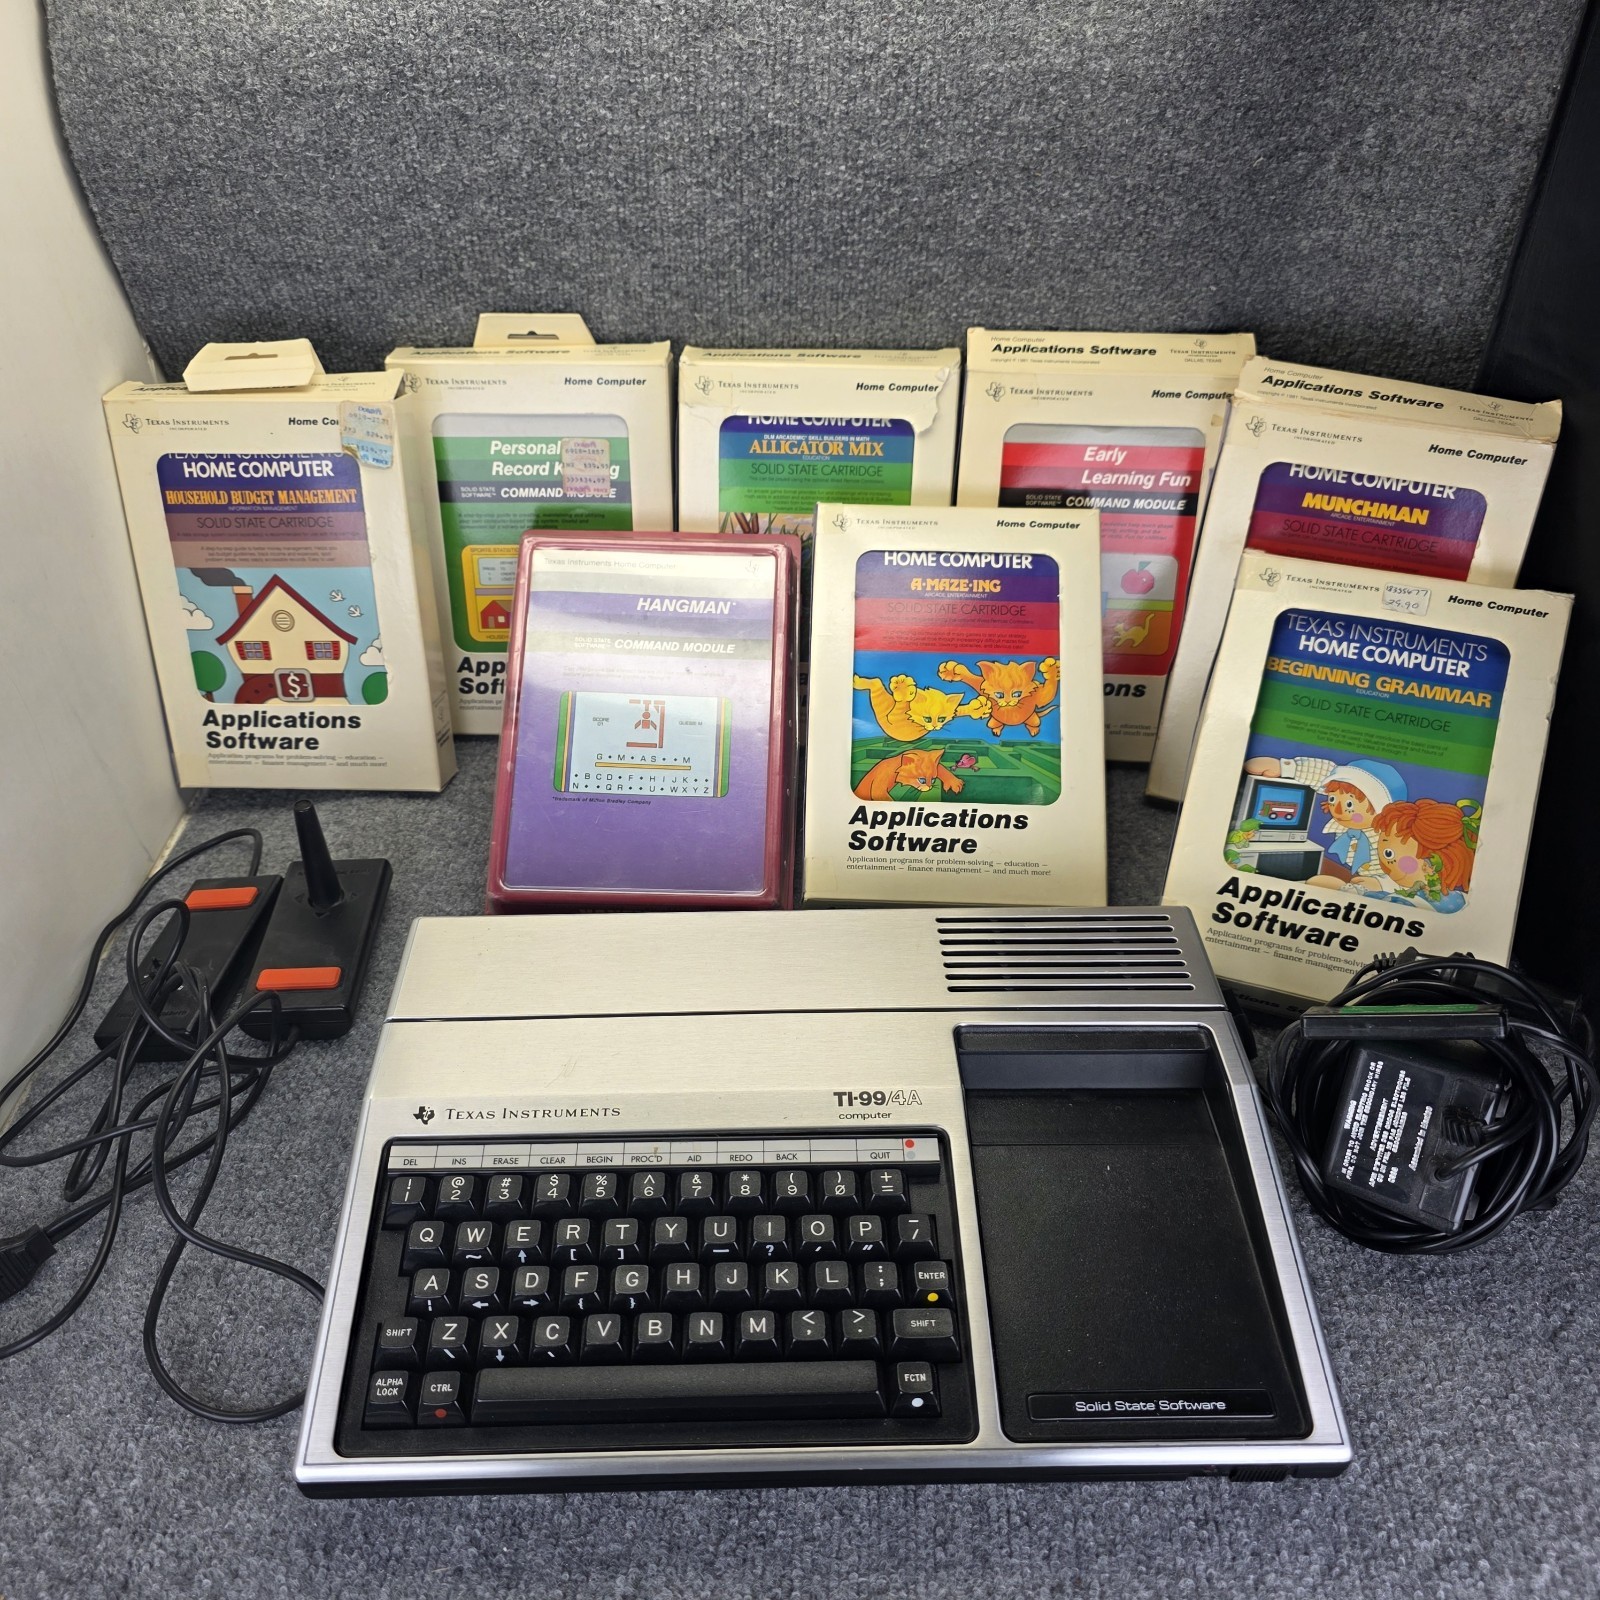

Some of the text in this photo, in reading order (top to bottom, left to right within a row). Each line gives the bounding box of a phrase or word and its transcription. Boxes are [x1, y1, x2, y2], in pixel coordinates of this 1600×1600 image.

[702, 351, 791, 359] Applications
[992, 344, 1157, 356] Applications Software
[1263, 366, 1323, 380] Home Computer
[425, 377, 507, 386] TEXAS INSTRUMENTS
[564, 376, 647, 388] Home Computer
[718, 380, 799, 389] TEXAS INSTRUMENTS
[856, 382, 939, 393] Home Computer
[1009, 386, 1093, 396] TEXAS INSTRUMENTS
[1151, 389, 1234, 400] Home Compute
[1261, 375, 1363, 398] Applications
[1368, 390, 1444, 410] Software
[145, 418, 230, 426] TEXAS INSTRUMENTS
[288, 417, 318, 426] Home
[747, 415, 799, 426] HOME
[1271, 423, 1363, 443] TEXAS INSTRUMENTS
[490, 440, 561, 455] Personal
[749, 440, 885, 457] ALLIGATOR MIX
[1428, 443, 1528, 466] Home Computer
[1083, 446, 1127, 466] Early
[182, 459, 335, 478] HOME COMPUTER
[491, 461, 550, 476] Record
[751, 463, 883, 477] SOLID STATE CARTRIDGE
[1081, 469, 1192, 489] Learning Fun
[1289, 463, 1458, 499] HOME COMPUTER
[165, 489, 357, 505] HOUSEHOLD BUDGET MANAGEMENT
[500, 487, 564, 498] COMMAND
[1065, 496, 1186, 511] COMMAND MODULE
[1301, 491, 1429, 526] MUNCHMAN
[197, 516, 334, 529] SOLID STATE CARTRIDGE
[856, 518, 939, 527] TEXAS INSTRUMENTS
[996, 520, 1081, 531] Home Computer
[1282, 518, 1320, 536] SOLID
[1323, 524, 1359, 541] STATE
[1362, 530, 1440, 553] CARTRIDGE
[544, 557, 566, 566] Texas
[567, 558, 612, 567] Instruments
[614, 560, 637, 568] Home
[884, 551, 1033, 569] HOME COMPUTER
[1286, 574, 1380, 593] TEXAS INSTRUMENTS
[888, 602, 1026, 617] SOLID STATE CARTRIDGE
[1448, 594, 1549, 619] Home Computer
[1286, 613, 1488, 662] TEXAS INSTRUMENTS
[614, 639, 736, 654] COMMAND MODULE
[1298, 635, 1471, 679] HOME COMPUTER
[1266, 656, 1492, 709] BEGINNING GRAMMAR
[1355, 688, 1390, 699] EDUCATION
[202, 709, 361, 731] Applications
[1290, 694, 1451, 733] SOLID STATE CARTRIDGE
[205, 730, 320, 751] Software
[848, 805, 1028, 830] Applications
[848, 830, 978, 854] Software
[846, 863, 896, 872] entertainment
[907, 865, 934, 873] finance
[935, 867, 982, 875] management
[992, 867, 1008, 875] and
[1008, 868, 1029, 876] much
[847, 856, 887, 865] Application
[889, 857, 924, 866] programs
[936, 858, 994, 868] problem-solving
[1004, 860, 1040, 868] education
[1216, 876, 1425, 939] Applications
[1211, 901, 1360, 953] Software
[1205, 936, 1261, 954] entertainment
[1273, 950, 1304, 964] finance
[1207, 927, 1366, 968] Application programs for problem-solvi
[833, 1089, 922, 1107] TI-99/4A
[445, 1107, 622, 1120] TEXAS INSTRUMENTS
[838, 1111, 892, 1120] computer
[403, 1158, 418, 1166] DEL
[451, 1157, 467, 1165] INS
[493, 1157, 519, 1165] ERASE
[540, 1156, 565, 1164] CLEAR
[586, 1155, 613, 1164] BEGIN
[687, 1154, 702, 1162] AID
[729, 1154, 753, 1162] REDO
[776, 1153, 798, 1161] BACK
[870, 1152, 891, 1160] QUIT
[419, 1227, 434, 1243] Q
[466, 1227, 486, 1242] W
[517, 1226, 531, 1242] E
[566, 1225, 580, 1240] R
[616, 1224, 630, 1240] T
[665, 1223, 678, 1238] Y
[713, 1222, 728, 1237] U
[767, 1221, 772, 1237] I
[810, 1221, 825, 1236] O
[859, 1221, 873, 1236] P
[918, 1271, 945, 1280] ENTER
[910, 1319, 936, 1328] SHIFT
[386, 1328, 412, 1337] SHIFT
[375, 1378, 404, 1387] ALPHA
[904, 1373, 926, 1382] FCTN
[376, 1387, 399, 1396] LOCK
[430, 1384, 453, 1393] CTRL
[1075, 1400, 1226, 1412] Solid State Software
